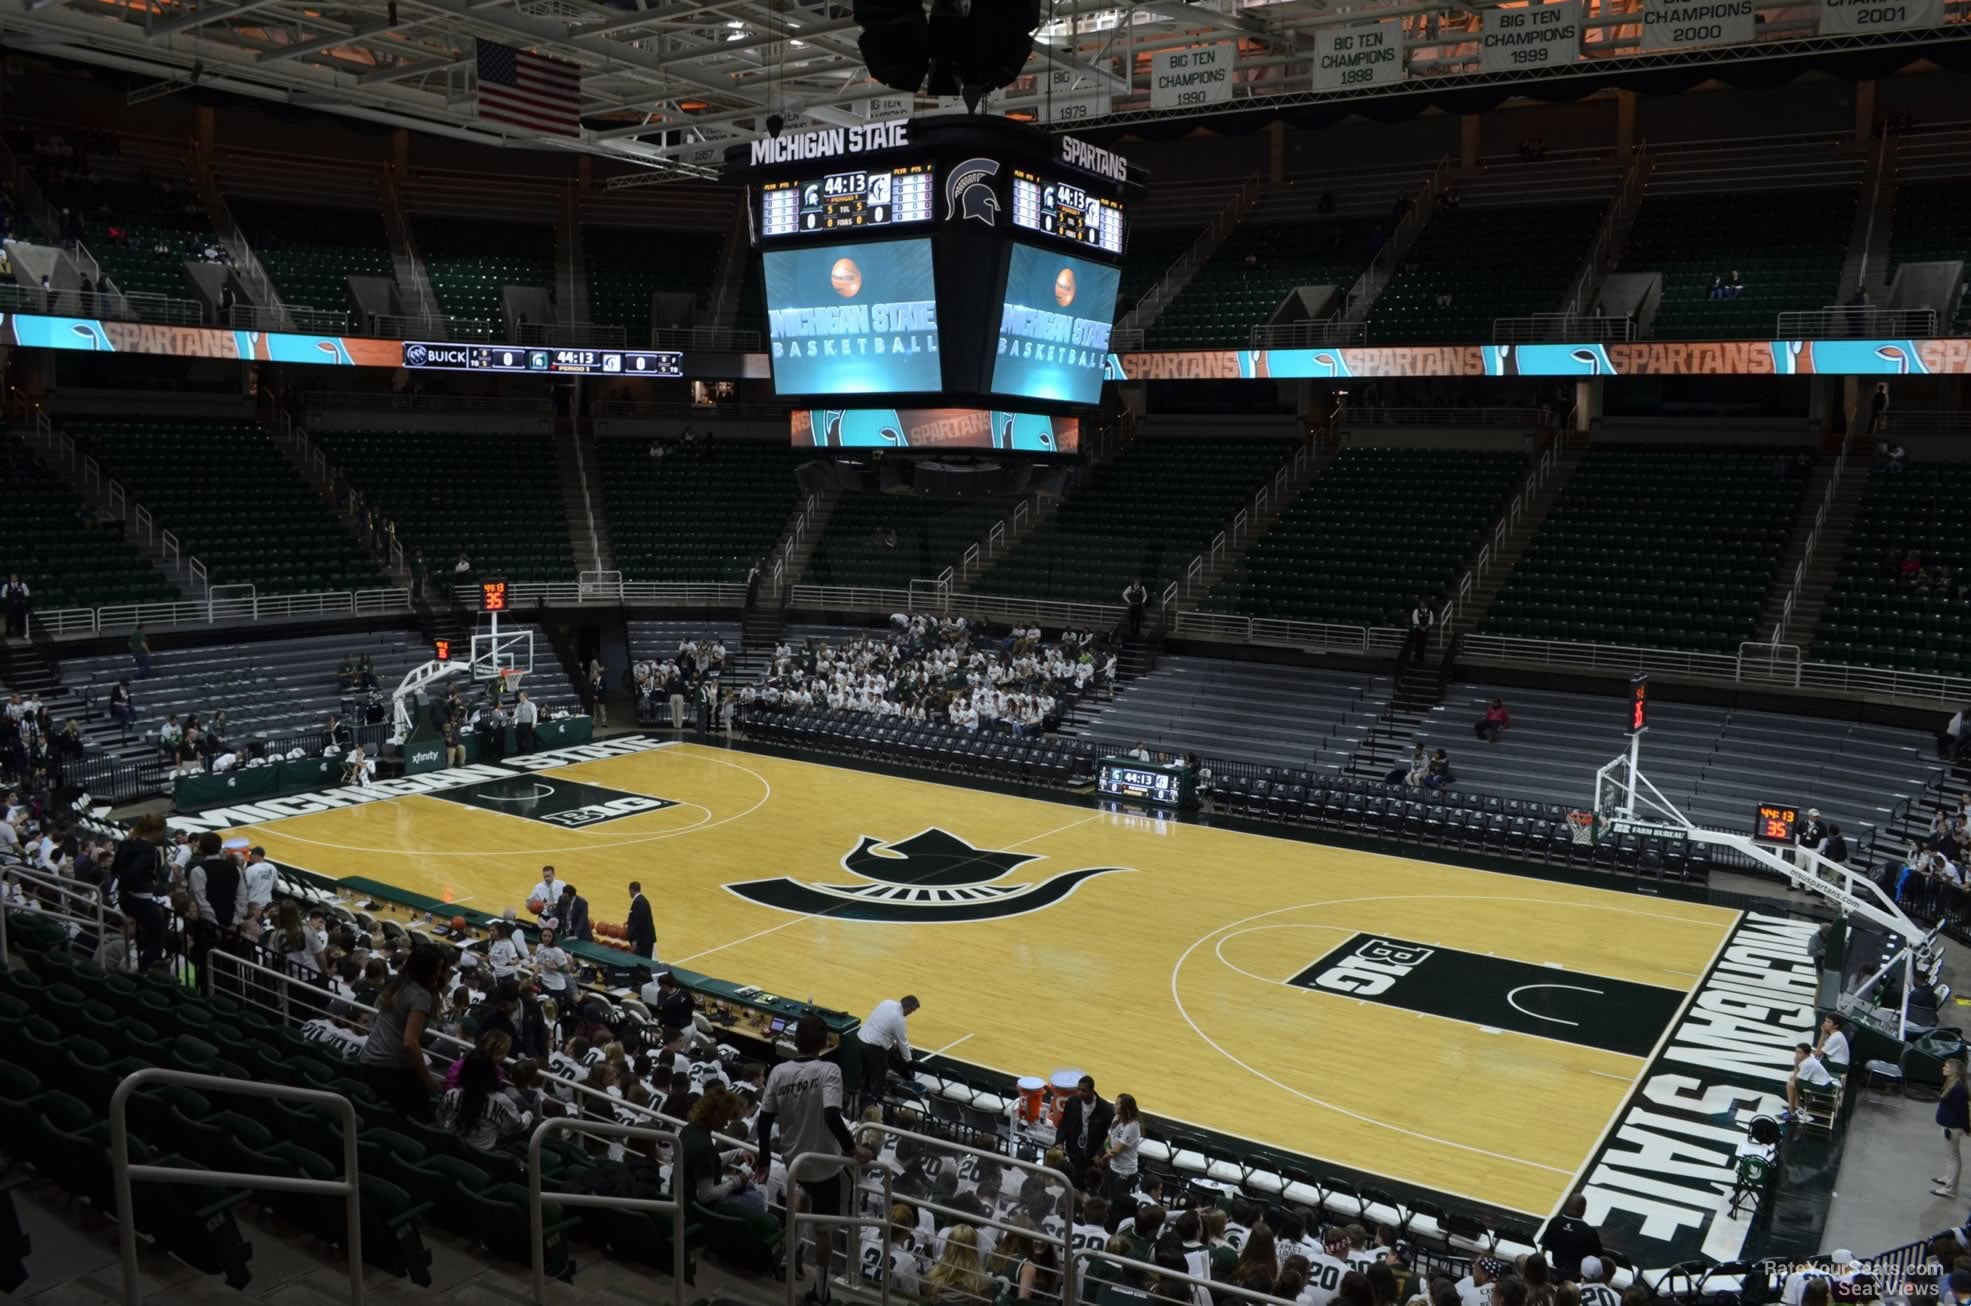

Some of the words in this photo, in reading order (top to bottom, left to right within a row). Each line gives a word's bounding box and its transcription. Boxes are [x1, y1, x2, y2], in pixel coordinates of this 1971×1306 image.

[1500, 13, 1527, 28] BIG
[1530, 8, 1561, 24] TEN
[1857, 7, 1906, 25] 2001
[1334, 36, 1354, 50] BIG
[1357, 32, 1383, 48] TEN
[1484, 25, 1576, 47] CHAMPIONS
[1673, 25, 1722, 43] 2000
[1169, 54, 1189, 69] BIG
[1192, 51, 1216, 66] TEN
[1321, 48, 1396, 70] CHAMPIONS
[1511, 47, 1548, 64] 1999
[1158, 68, 1226, 89] CHAMPIONS
[1341, 68, 1374, 85] 1998
[1060, 105, 1087, 119] 1979
[750, 127, 846, 166] MICHIGAN
[848, 118, 910, 152] STATE
[1062, 135, 1127, 182] SPARTANS
[824, 174, 866, 195] 44:13
[1057, 186, 1085, 209] 44:13
[807, 213, 816, 229] 0
[874, 206, 884, 222] 0
[768, 304, 870, 338] MICHIGAN
[872, 301, 938, 333] STATE
[1000, 303, 1074, 344] MICHIGAN
[1071, 317, 1113, 351] STATE
[106, 320, 238, 359] SPARTANS
[772, 335, 938, 359] BASKETBALL
[428, 350, 466, 363] BUICK
[503, 352, 513, 366] 0
[557, 351, 594, 364] 44:13
[636, 357, 646, 370] 0
[998, 337, 1106, 370] BASKETBALL
[1347, 346, 1482, 376] SPARTANS
[1610, 342, 1773, 375] SPARTANS
[1921, 340, 1971, 373] SP
[1122, 351, 1238, 379] SPARTANS
[911, 412, 991, 446] SPARTANS
[486, 593, 504, 609] 35
[412, 750, 438, 764] xfinity
[166, 763, 520, 834] MICHIGAN
[501, 735, 684, 770] STATE
[1125, 773, 1152, 785] 44:13
[1761, 807, 1796, 823] 44:13
[1766, 820, 1786, 838] 35
[1790, 868, 1861, 910] msuspartans.com
[1664, 911, 1821, 1082] MICHIGAN
[550, 1059, 576, 1082] 20
[778, 1083, 796, 1097] JUST
[797, 1080, 809, 1092] DO
[1583, 1073, 1789, 1263] STATE
[1072, 1233, 1104, 1252] 20
[1310, 1261, 1340, 1291] 20
